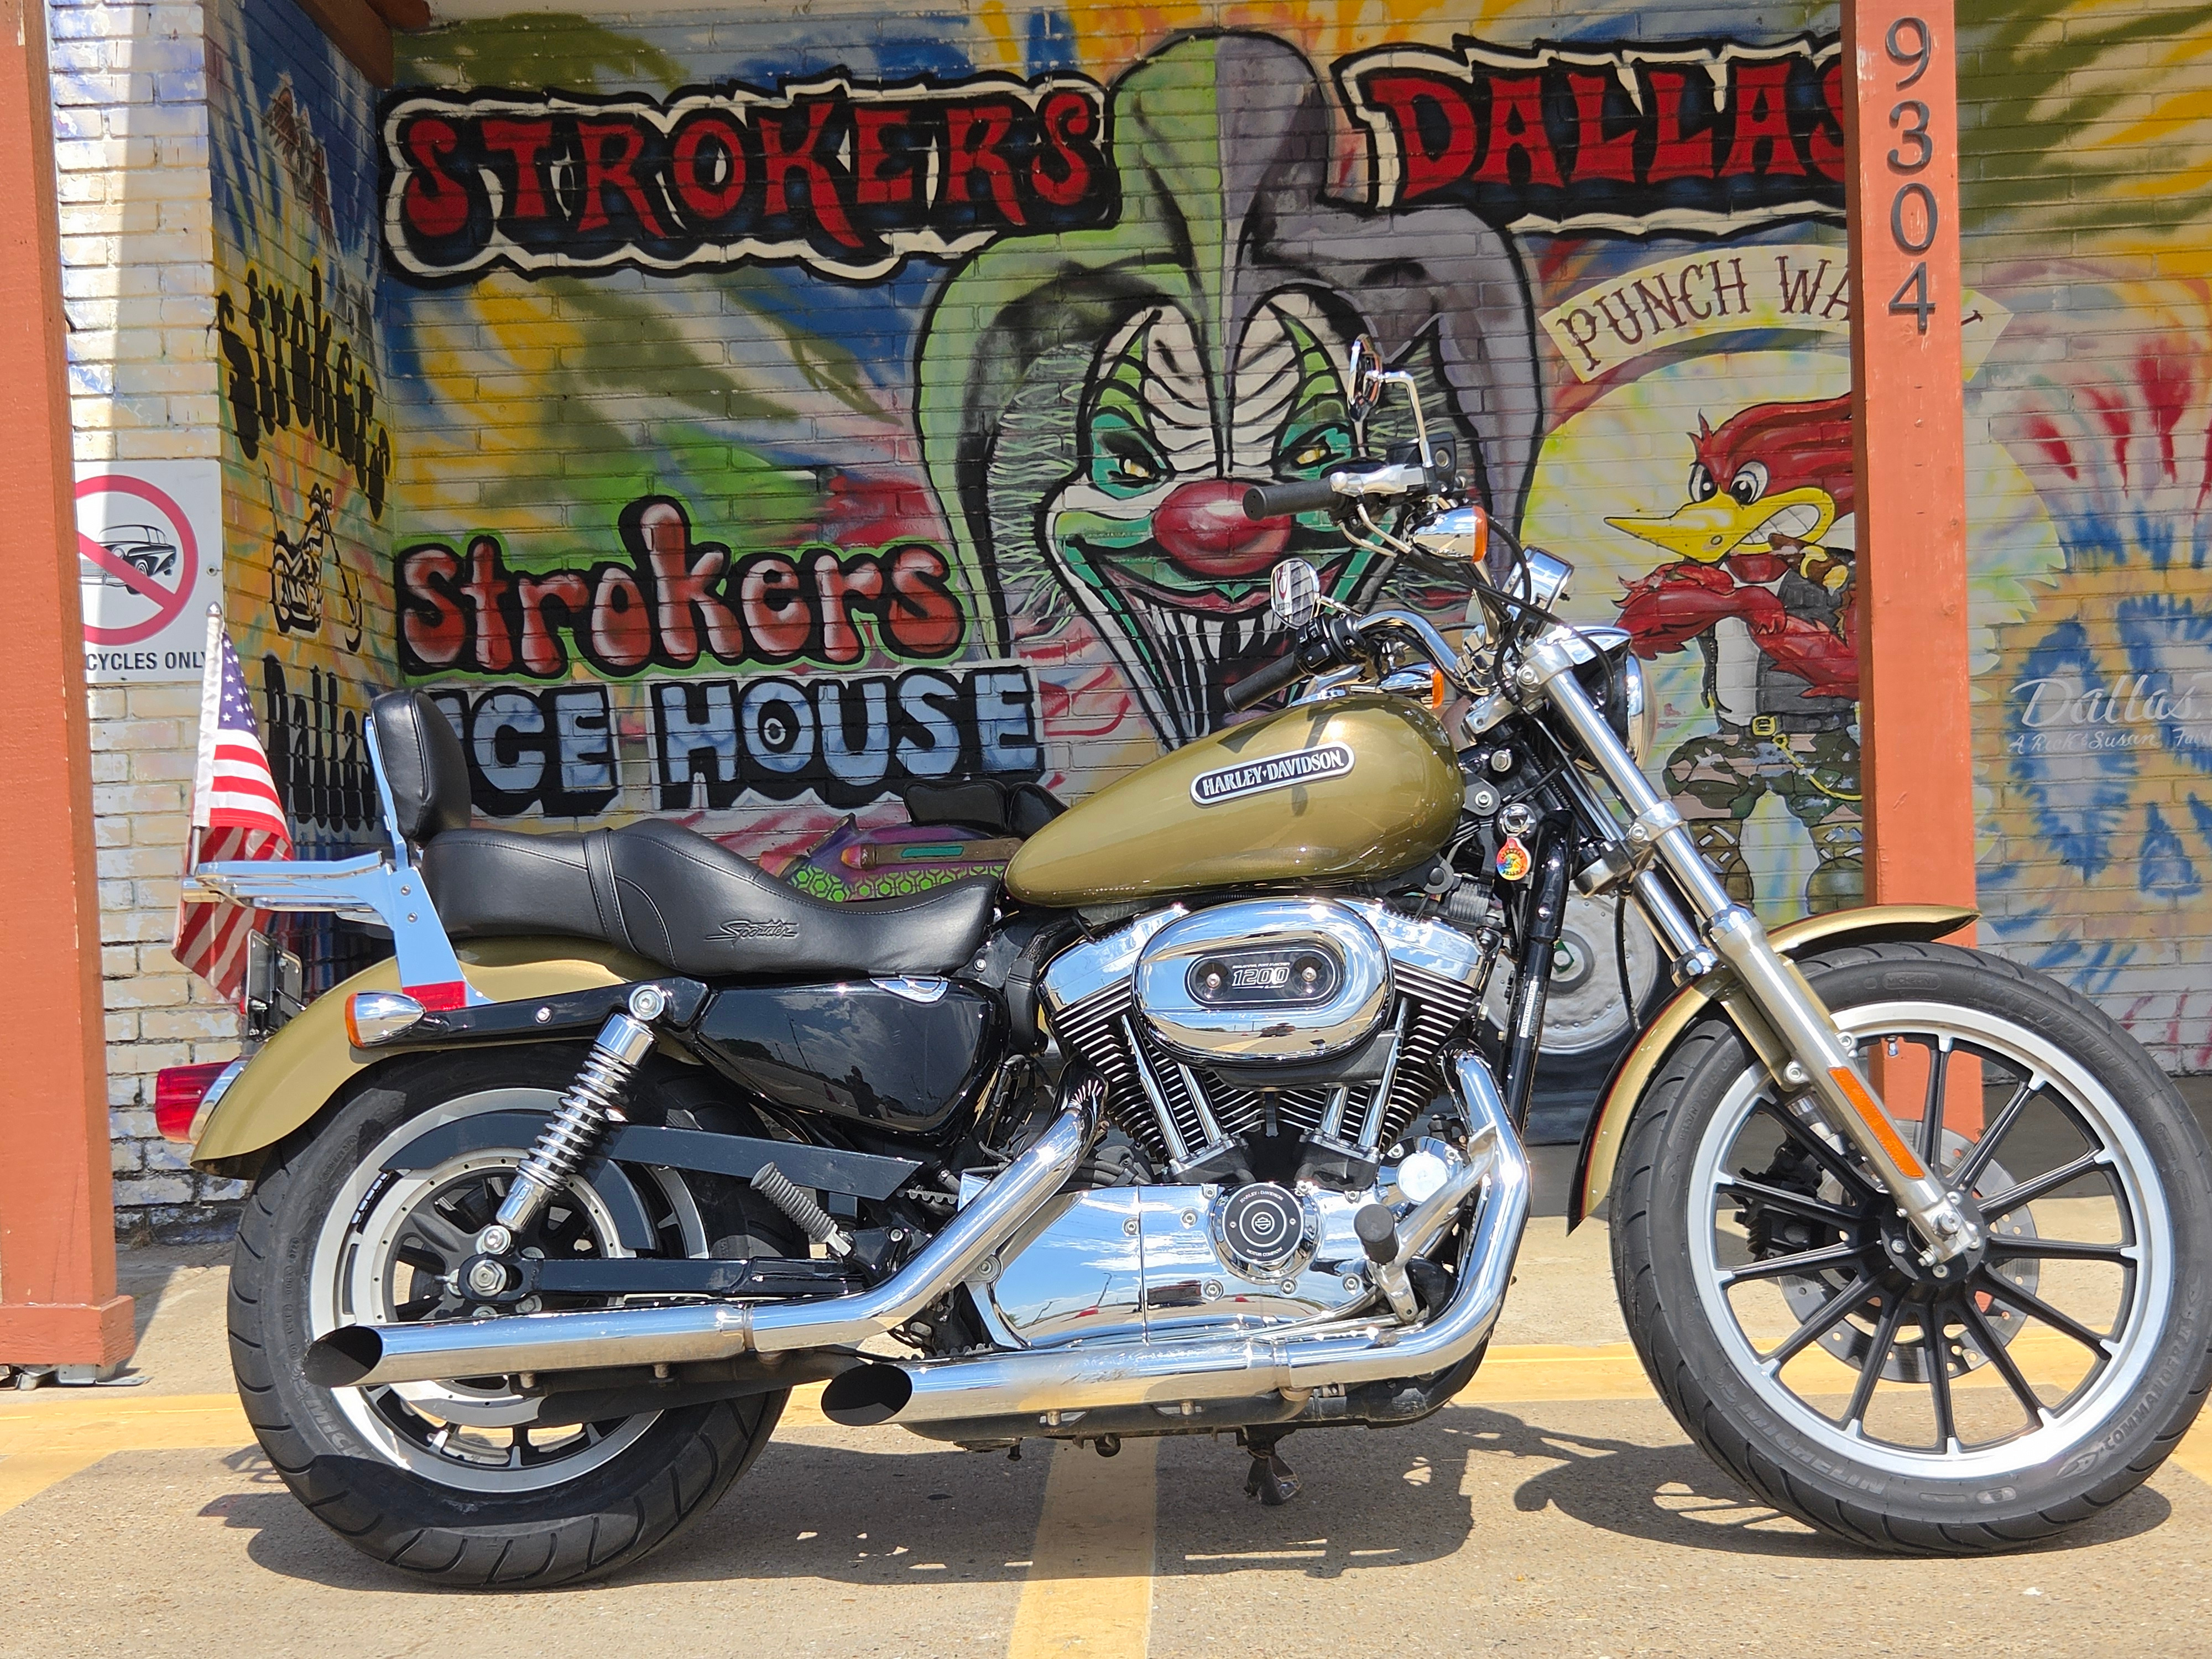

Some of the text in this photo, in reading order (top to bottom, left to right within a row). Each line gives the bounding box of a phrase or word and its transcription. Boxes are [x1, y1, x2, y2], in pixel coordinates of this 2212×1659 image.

[406, 92, 1091, 249] STROKERS
[1885, 17, 1938, 335] 9304
[1556, 256, 1750, 372] PUNCH
[402, 502, 966, 676] Strokers
[86, 651, 206, 671] CYCLES ONL
[663, 671, 1045, 787] HOUSE
[1231, 967, 1290, 987] 1200
[1739, 1402, 1886, 1495] MICHELIN
